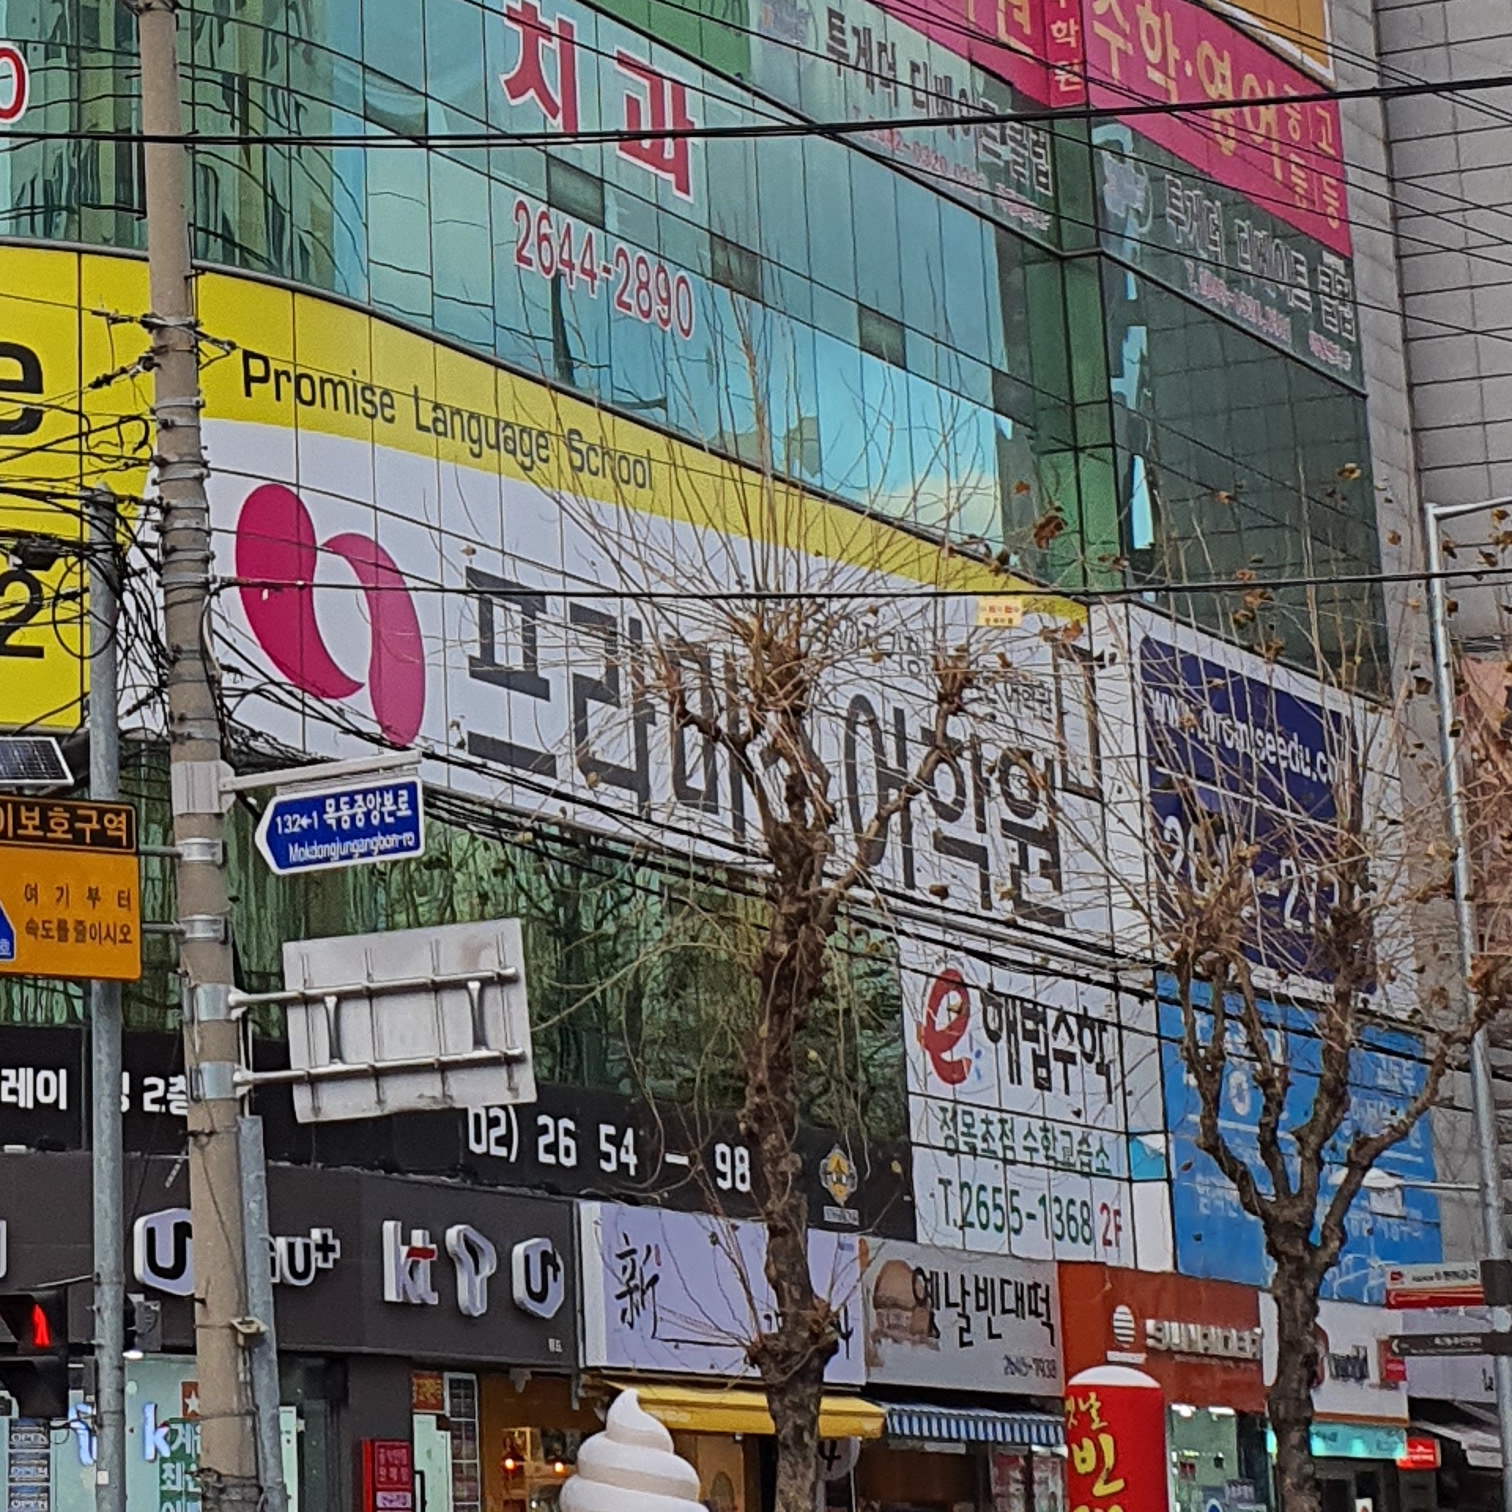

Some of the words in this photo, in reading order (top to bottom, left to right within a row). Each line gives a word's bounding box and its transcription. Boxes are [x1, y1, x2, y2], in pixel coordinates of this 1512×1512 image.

[513, 199, 695, 340] 2644-2890
[243, 349, 396, 425] Promise
[414, 384, 550, 473] Language
[565, 427, 655, 491] School
[323, 789, 413, 831] 목동중앙본로
[599, 1124, 638, 1176] 54
[1100, 1202, 1123, 1248] 2F
